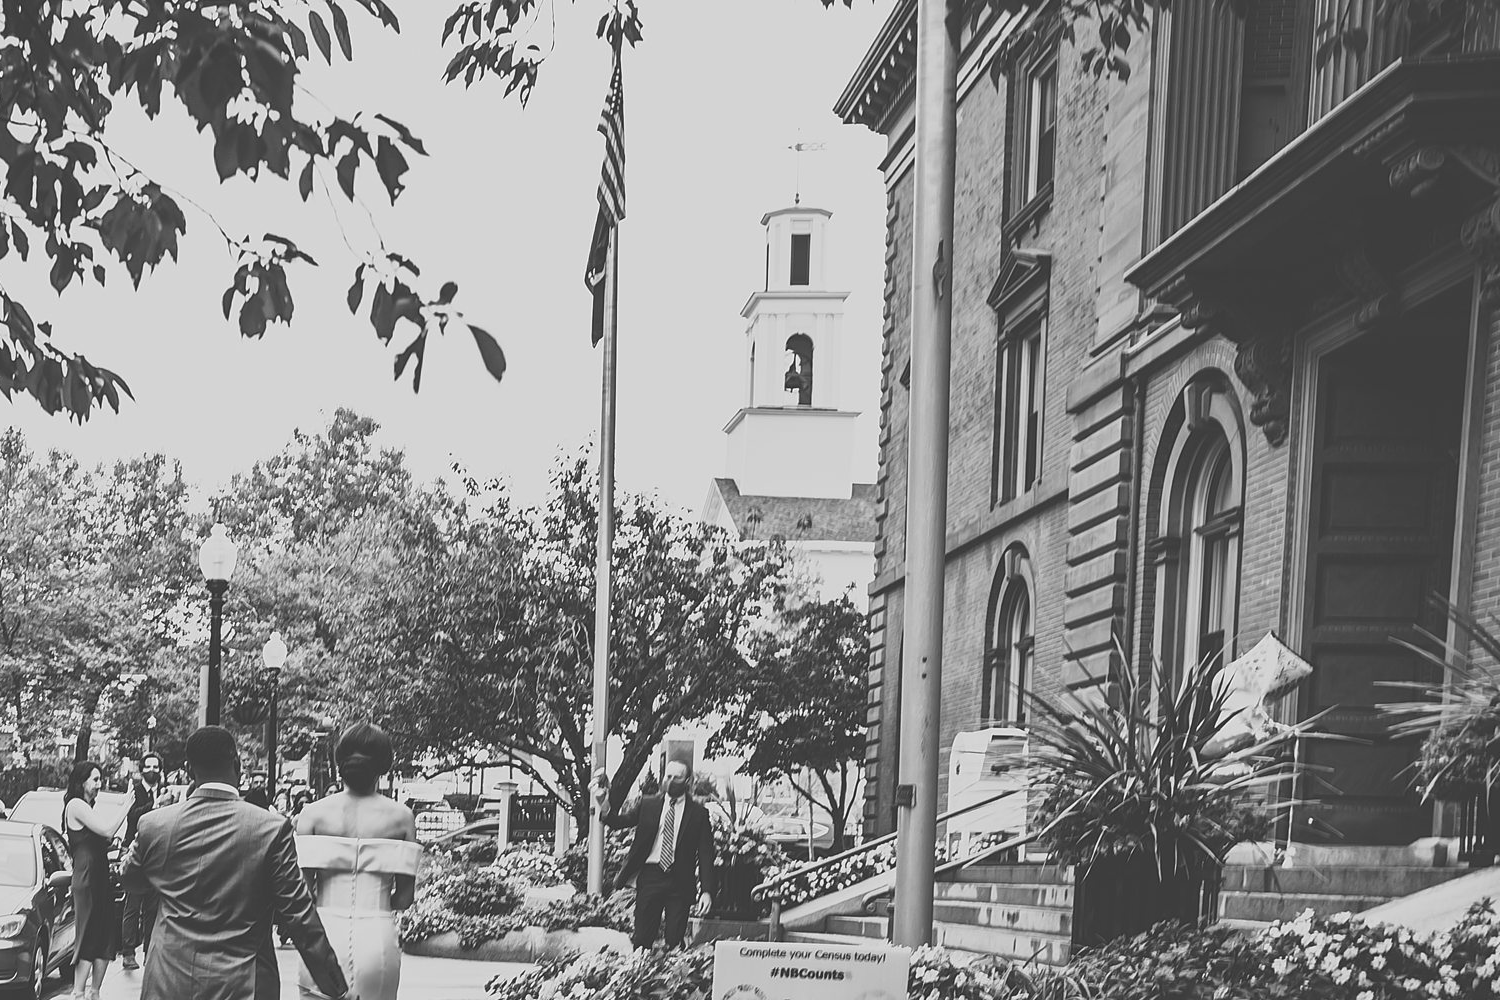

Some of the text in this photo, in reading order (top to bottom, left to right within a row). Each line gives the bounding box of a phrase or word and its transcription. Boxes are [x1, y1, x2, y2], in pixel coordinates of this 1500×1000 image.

[739, 947, 886, 965] Complete your Census today!
[770, 967, 845, 981] #NBCounts
